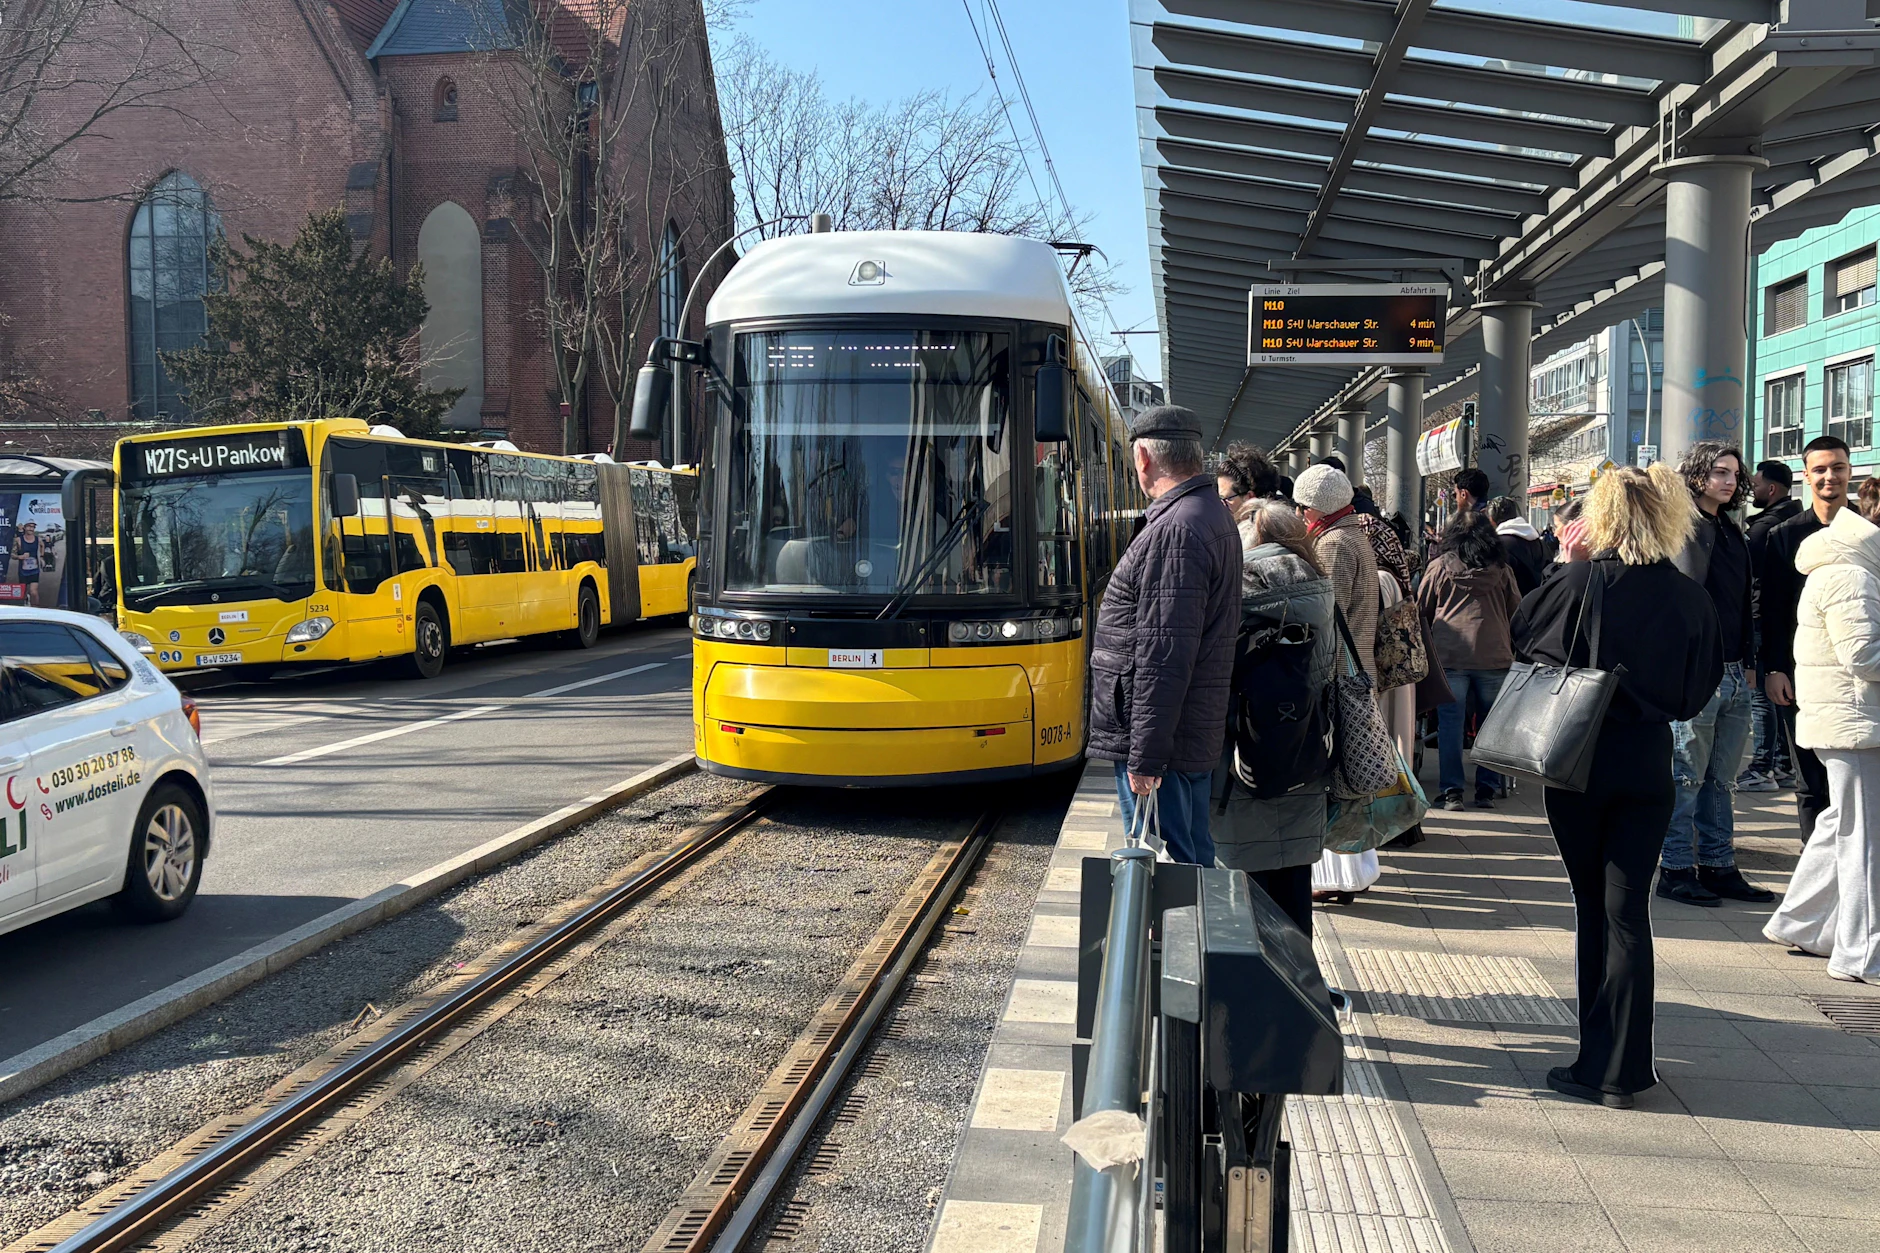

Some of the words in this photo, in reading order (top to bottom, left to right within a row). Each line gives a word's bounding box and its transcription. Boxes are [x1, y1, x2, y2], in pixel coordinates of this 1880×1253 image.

[1264, 287, 1281, 295] Linie
[1287, 287, 1300, 295] Ziel
[1400, 286, 1428, 294] Abfahrt
[1429, 286, 1436, 294] in
[1263, 300, 1285, 311] M10
[1263, 319, 1284, 329] M10
[1286, 319, 1304, 329] S+U
[1307, 319, 1360, 329] Warschauer
[1363, 318, 1379, 329] Str.
[1410, 319, 1416, 328] 4
[1417, 318, 1436, 329] min
[1262, 338, 1283, 348] M10
[1286, 338, 1303, 348] S+U
[1306, 338, 1360, 348] Warschauer
[1362, 337, 1378, 348] Str.
[1409, 337, 1416, 347] 9
[1416, 337, 1435, 347] min
[145, 448, 175, 474] M27
[175, 447, 213, 469] S+U
[216, 443, 285, 466] Pankow
[309, 604, 330, 612] 5234
[202, 656, 208, 664] B
[212, 655, 218, 663] V
[219, 654, 238, 663] 5234
[832, 654, 861, 662] BERLIN
[1040, 722, 1072, 746] 9078-A
[52, 767, 74, 788] 030
[75, 762, 90, 780] 30
[91, 756, 105, 774] 20
[106, 751, 119, 768] 87
[121, 745, 135, 763] 88
[55, 769, 142, 814] www.dosteli.de
